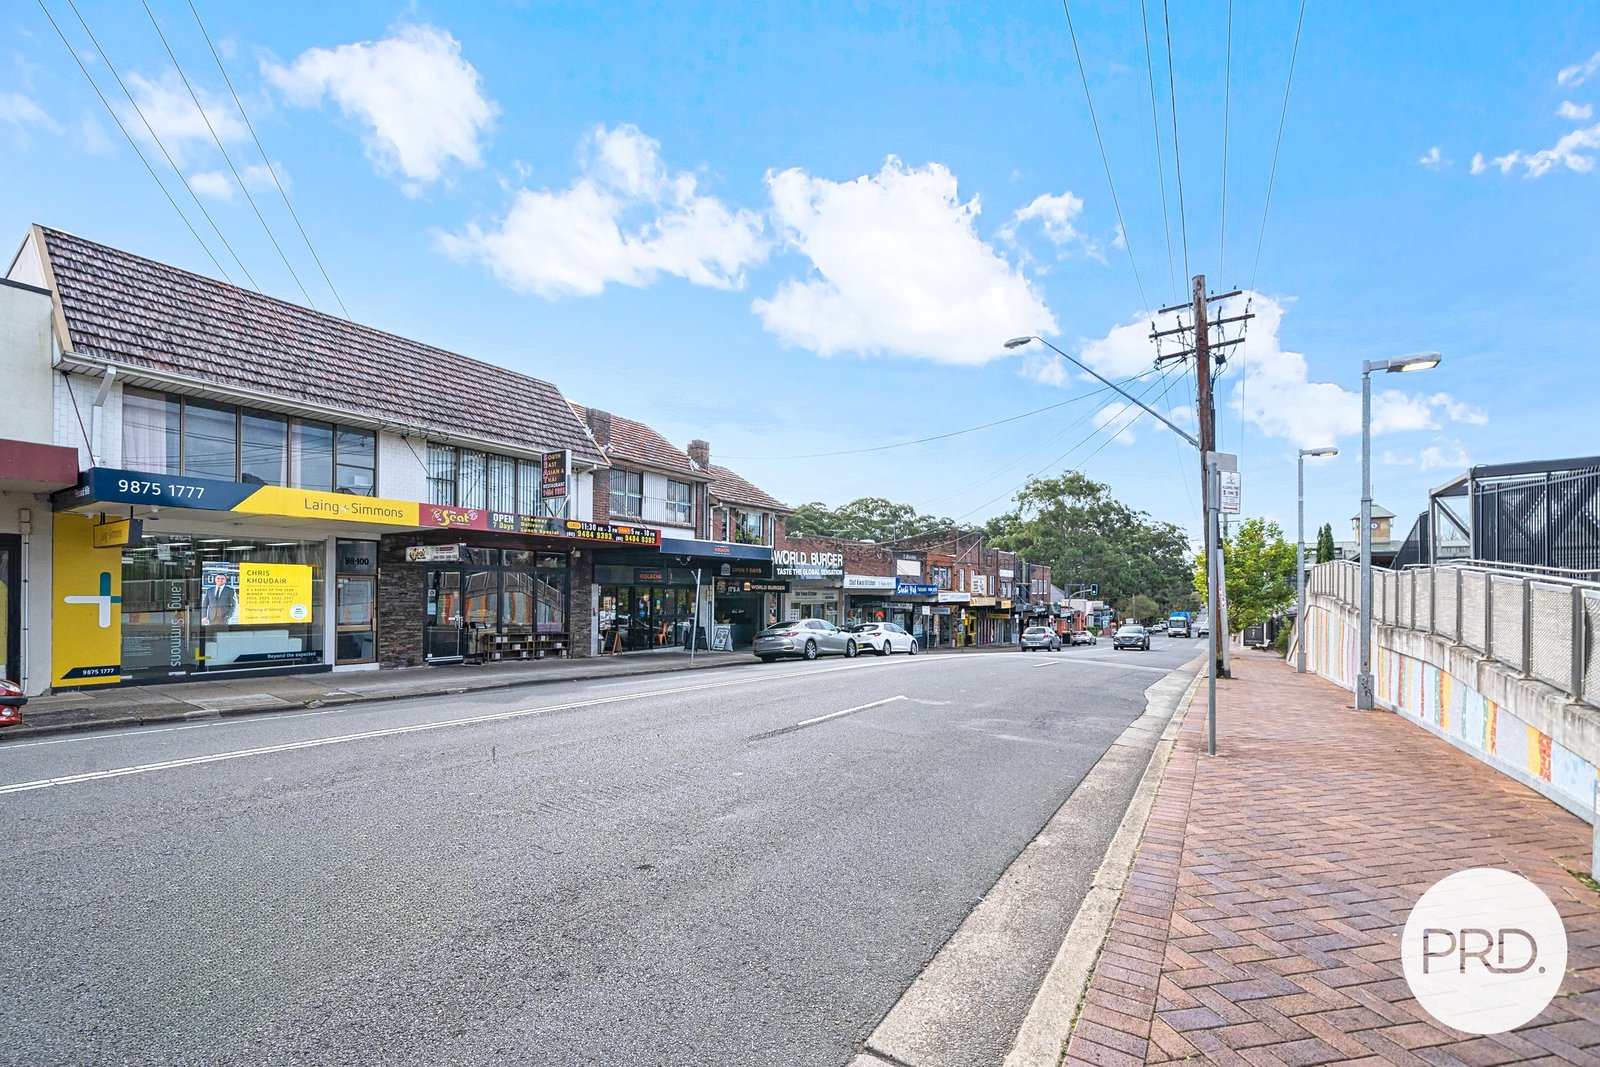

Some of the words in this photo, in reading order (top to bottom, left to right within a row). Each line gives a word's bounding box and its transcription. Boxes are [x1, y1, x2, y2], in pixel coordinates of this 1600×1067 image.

[118, 480, 161, 496] 9875
[168, 484, 204, 499] 1777
[304, 498, 339, 514] Laing
[352, 502, 404, 518] Simmons
[493, 514, 514, 524] OPEN
[582, 523, 596, 531] 11:30
[578, 530, 594, 538] 9484
[774, 550, 806, 566] WORLD
[810, 552, 844, 566] BURGER
[168, 580, 184, 609] Laing
[170, 618, 184, 667] Simmons
